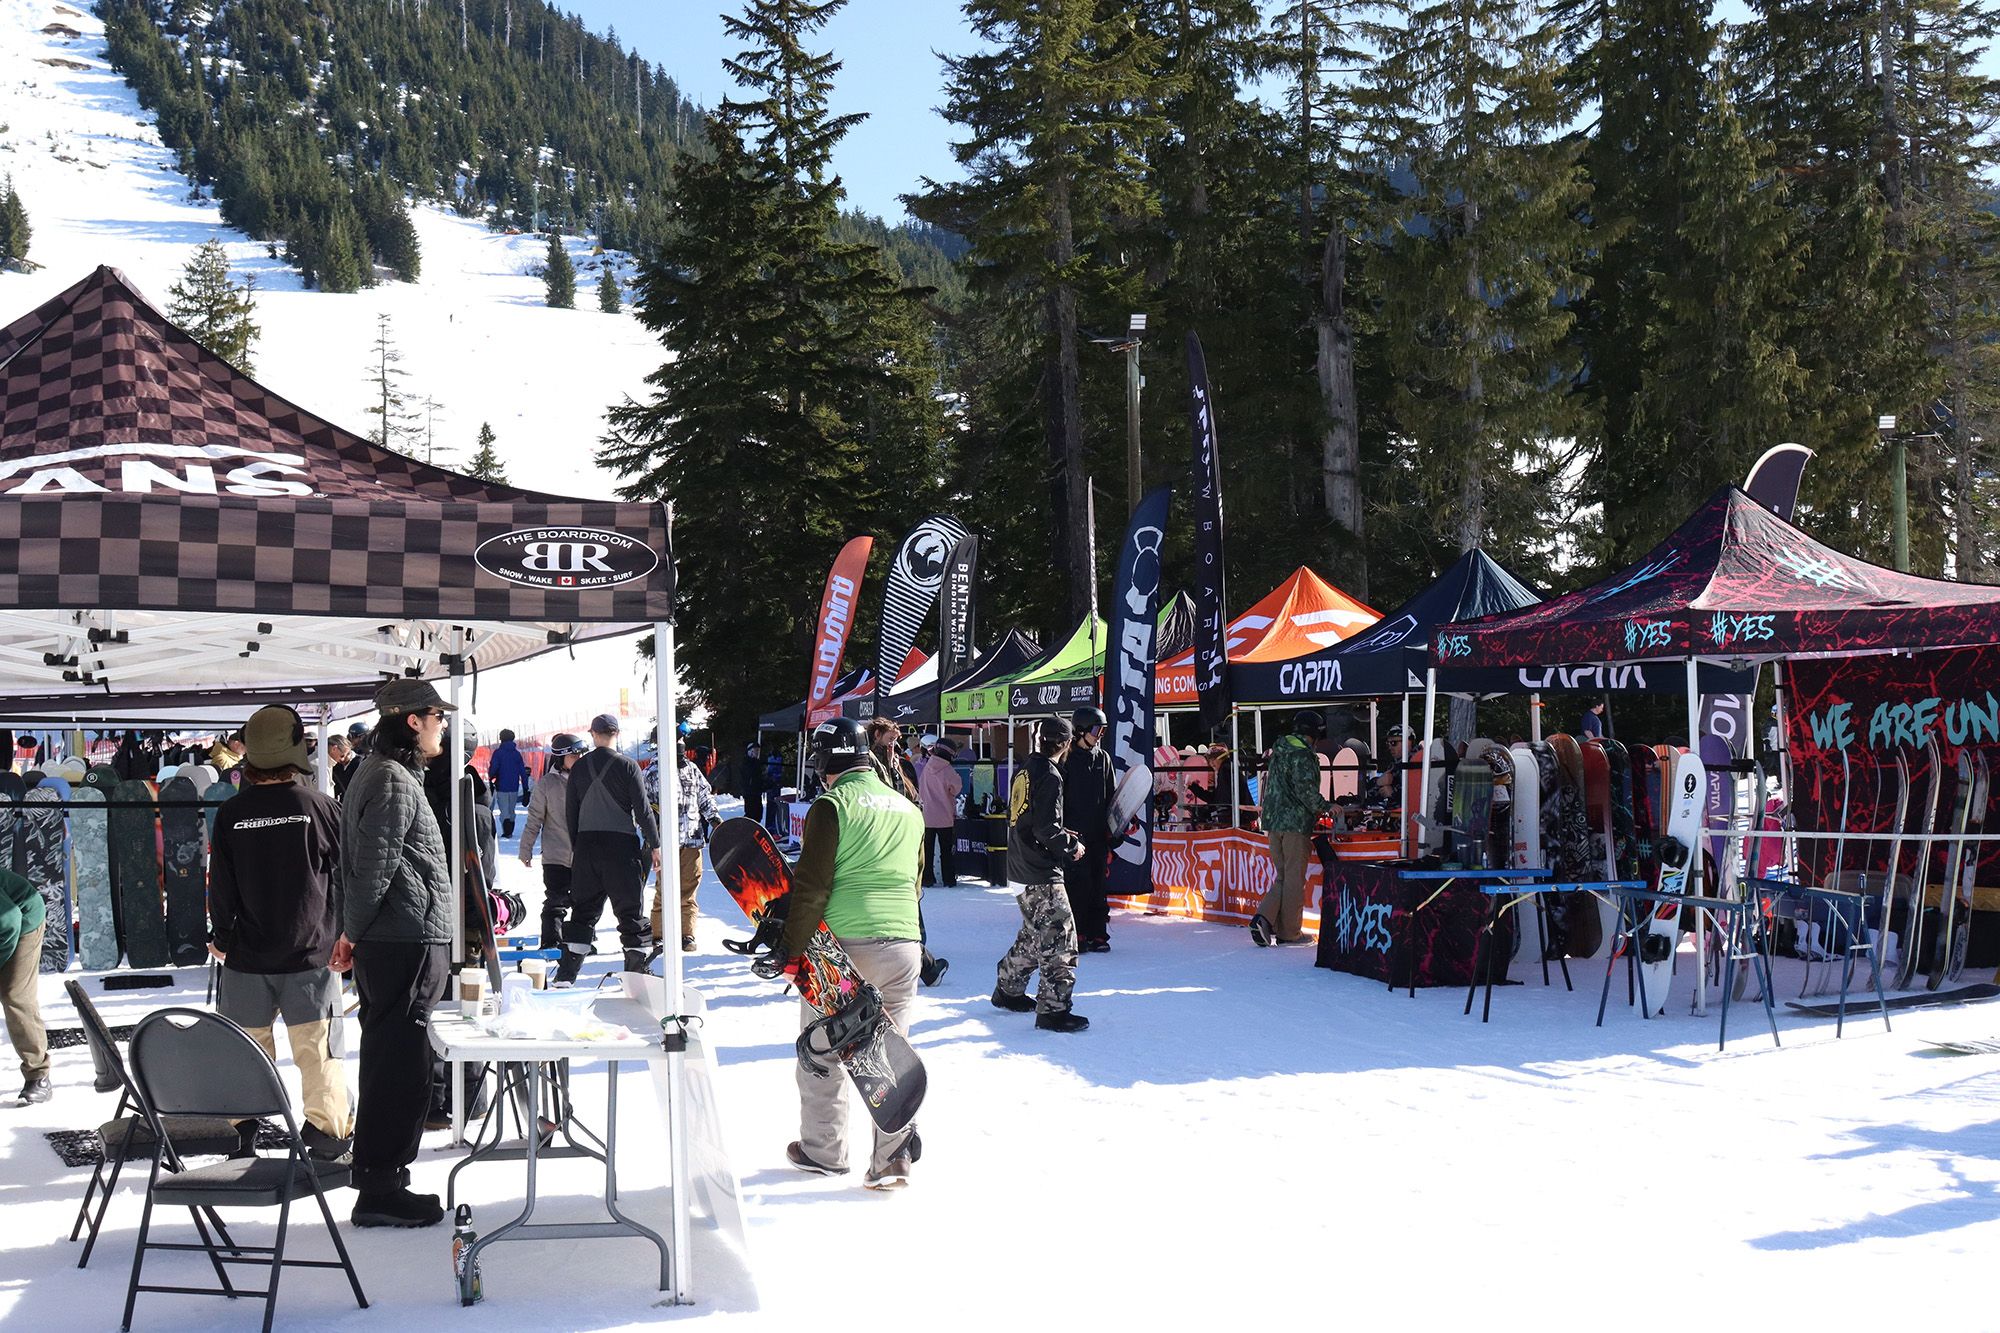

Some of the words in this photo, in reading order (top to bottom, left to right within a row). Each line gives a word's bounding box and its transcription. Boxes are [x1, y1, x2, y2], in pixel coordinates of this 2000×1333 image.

[0, 443, 313, 496] ANS
[503, 533, 534, 546] THE
[538, 531, 633, 549] BOARDROOM
[499, 567, 524, 580] SNOW
[528, 575, 552, 585] WAKE
[580, 576, 607, 585] SKATE
[613, 570, 633, 582] SURF
[1810, 702, 1855, 750] WE
[1868, 697, 1942, 750] ARE
[1336, 883, 1393, 955] #YES
